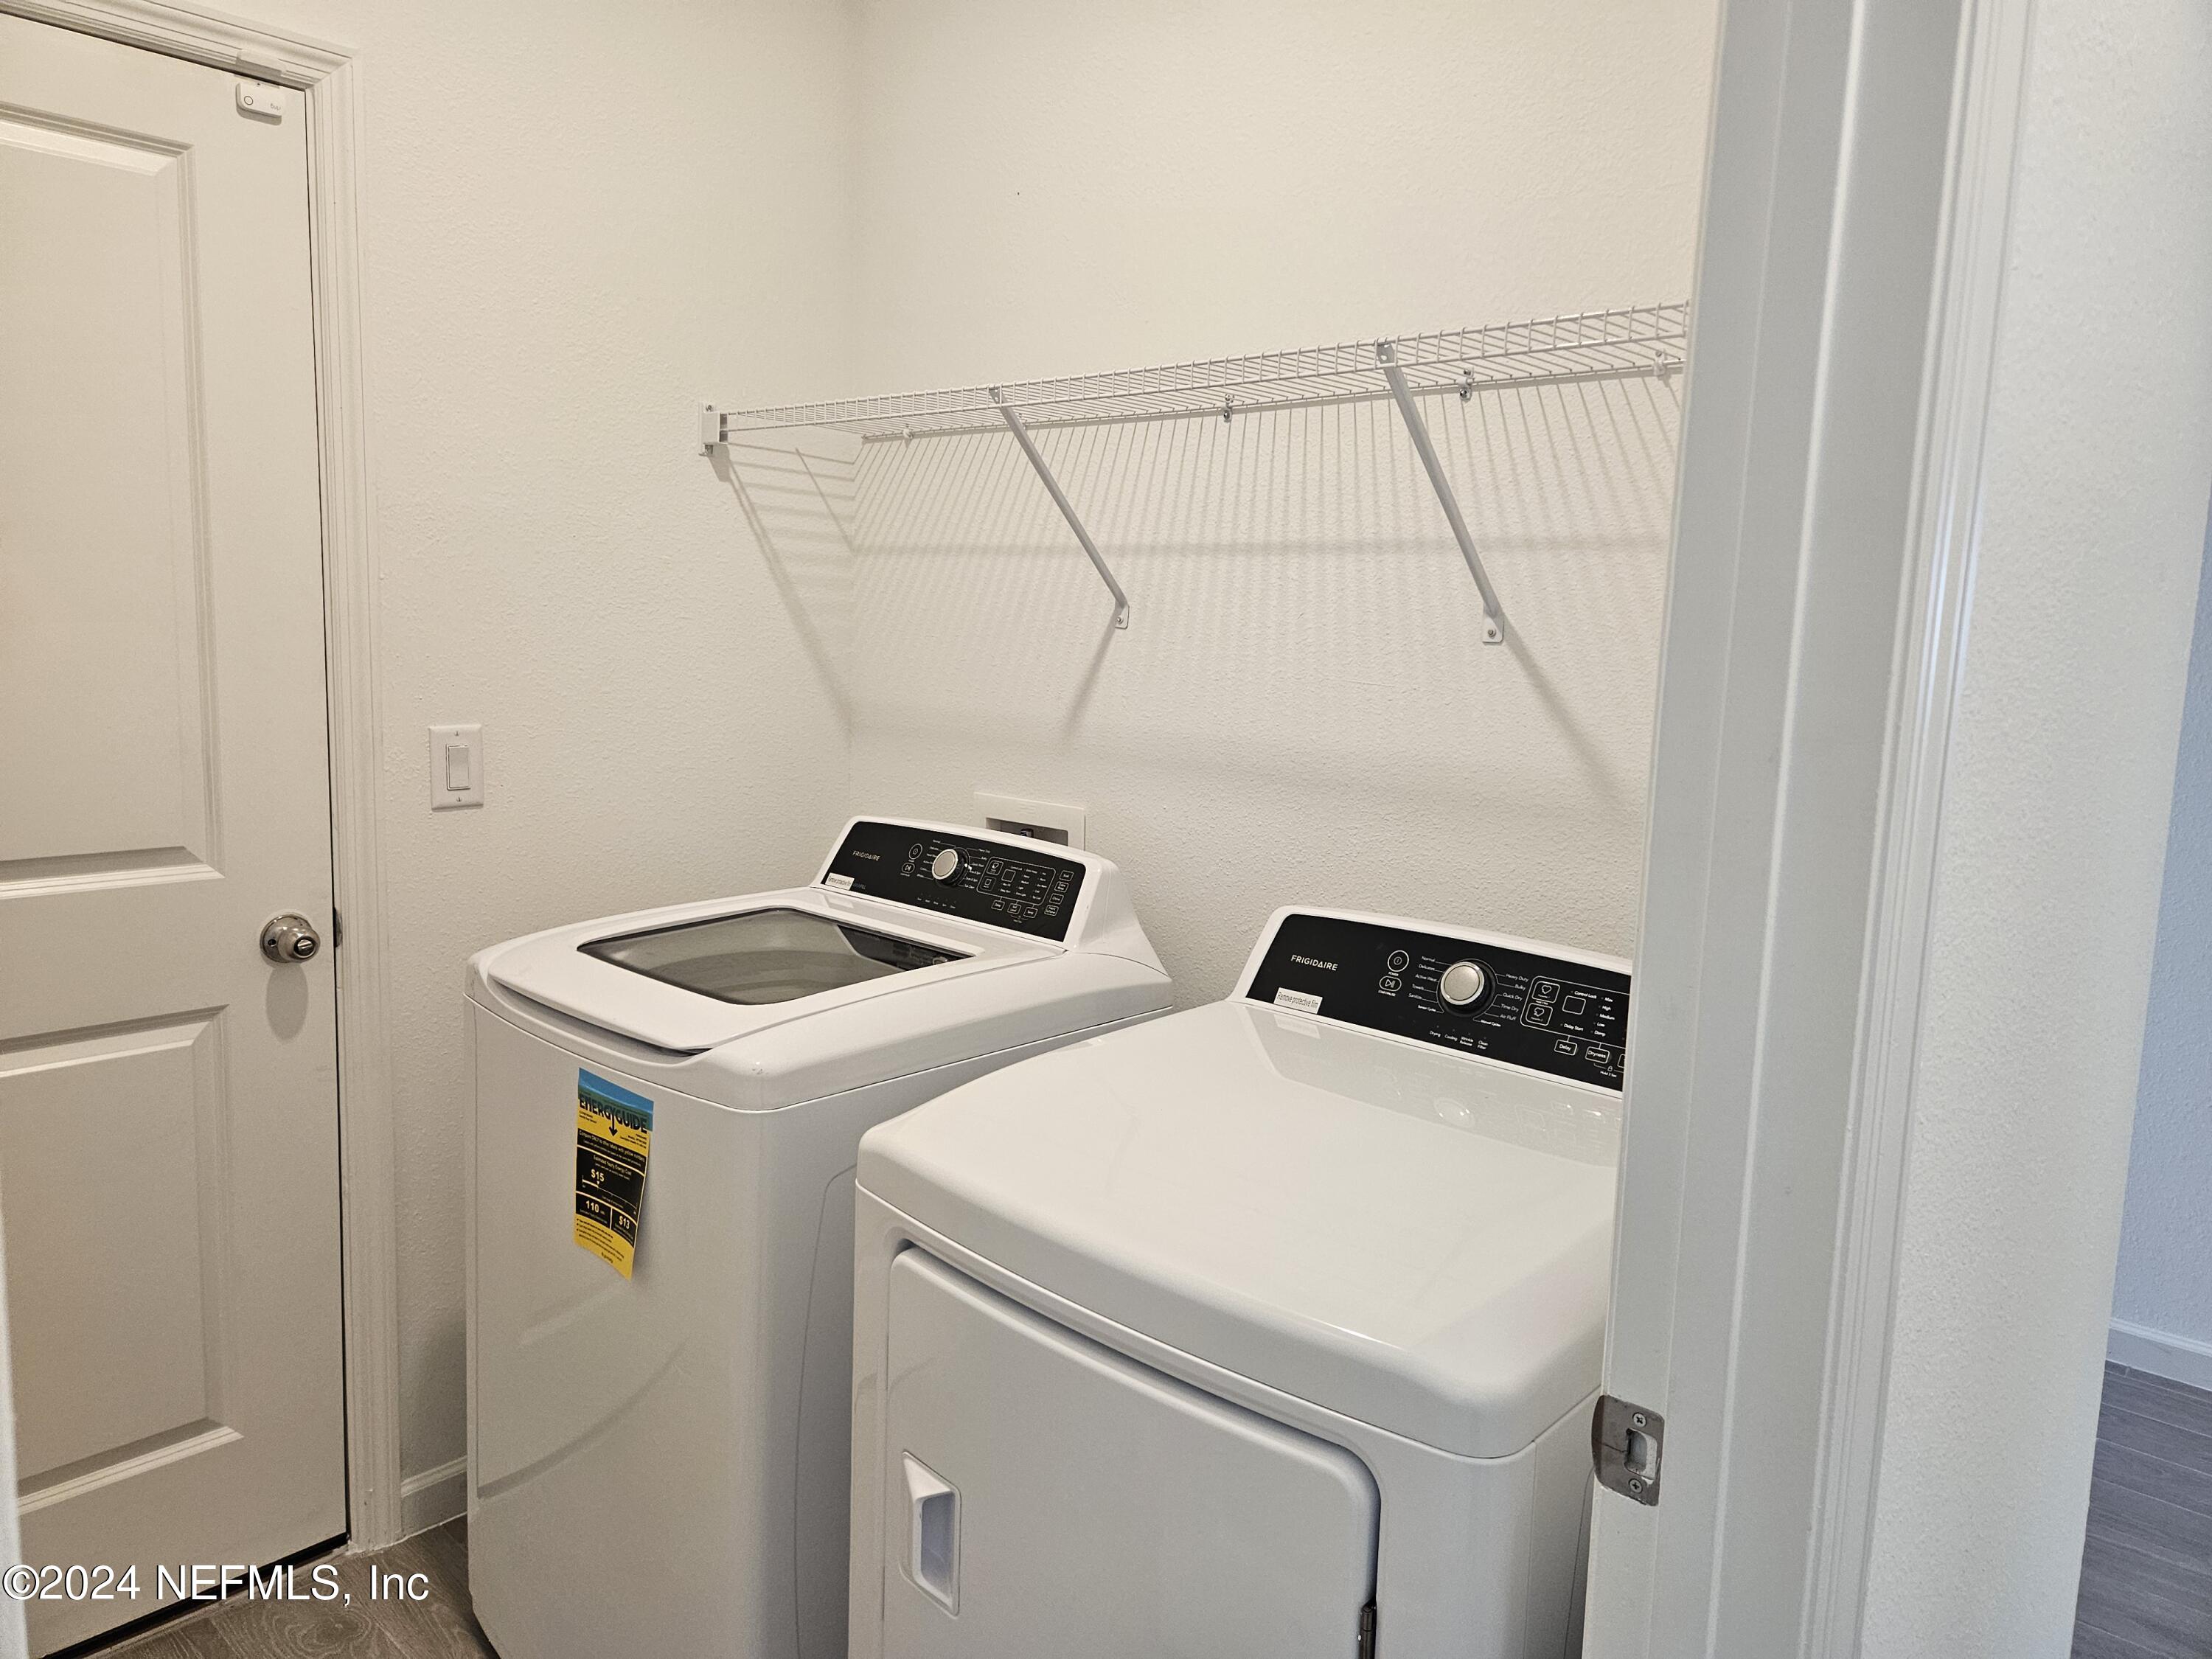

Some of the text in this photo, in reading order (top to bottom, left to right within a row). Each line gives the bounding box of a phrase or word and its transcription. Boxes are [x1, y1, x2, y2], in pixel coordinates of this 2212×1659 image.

[852, 850, 880, 861] FRIGIDAIRE
[1290, 954, 1338, 971] FRIGIDAIRE
[1276, 991, 1319, 1009] Remove protective film
[1444, 1034, 1458, 1042] Cooling
[1559, 1043, 1571, 1051] Delay
[1587, 1050, 1606, 1058] Dryness
[591, 1169, 605, 1182] $15
[585, 1200, 599, 1213] 110
[619, 1215, 630, 1229] $13
